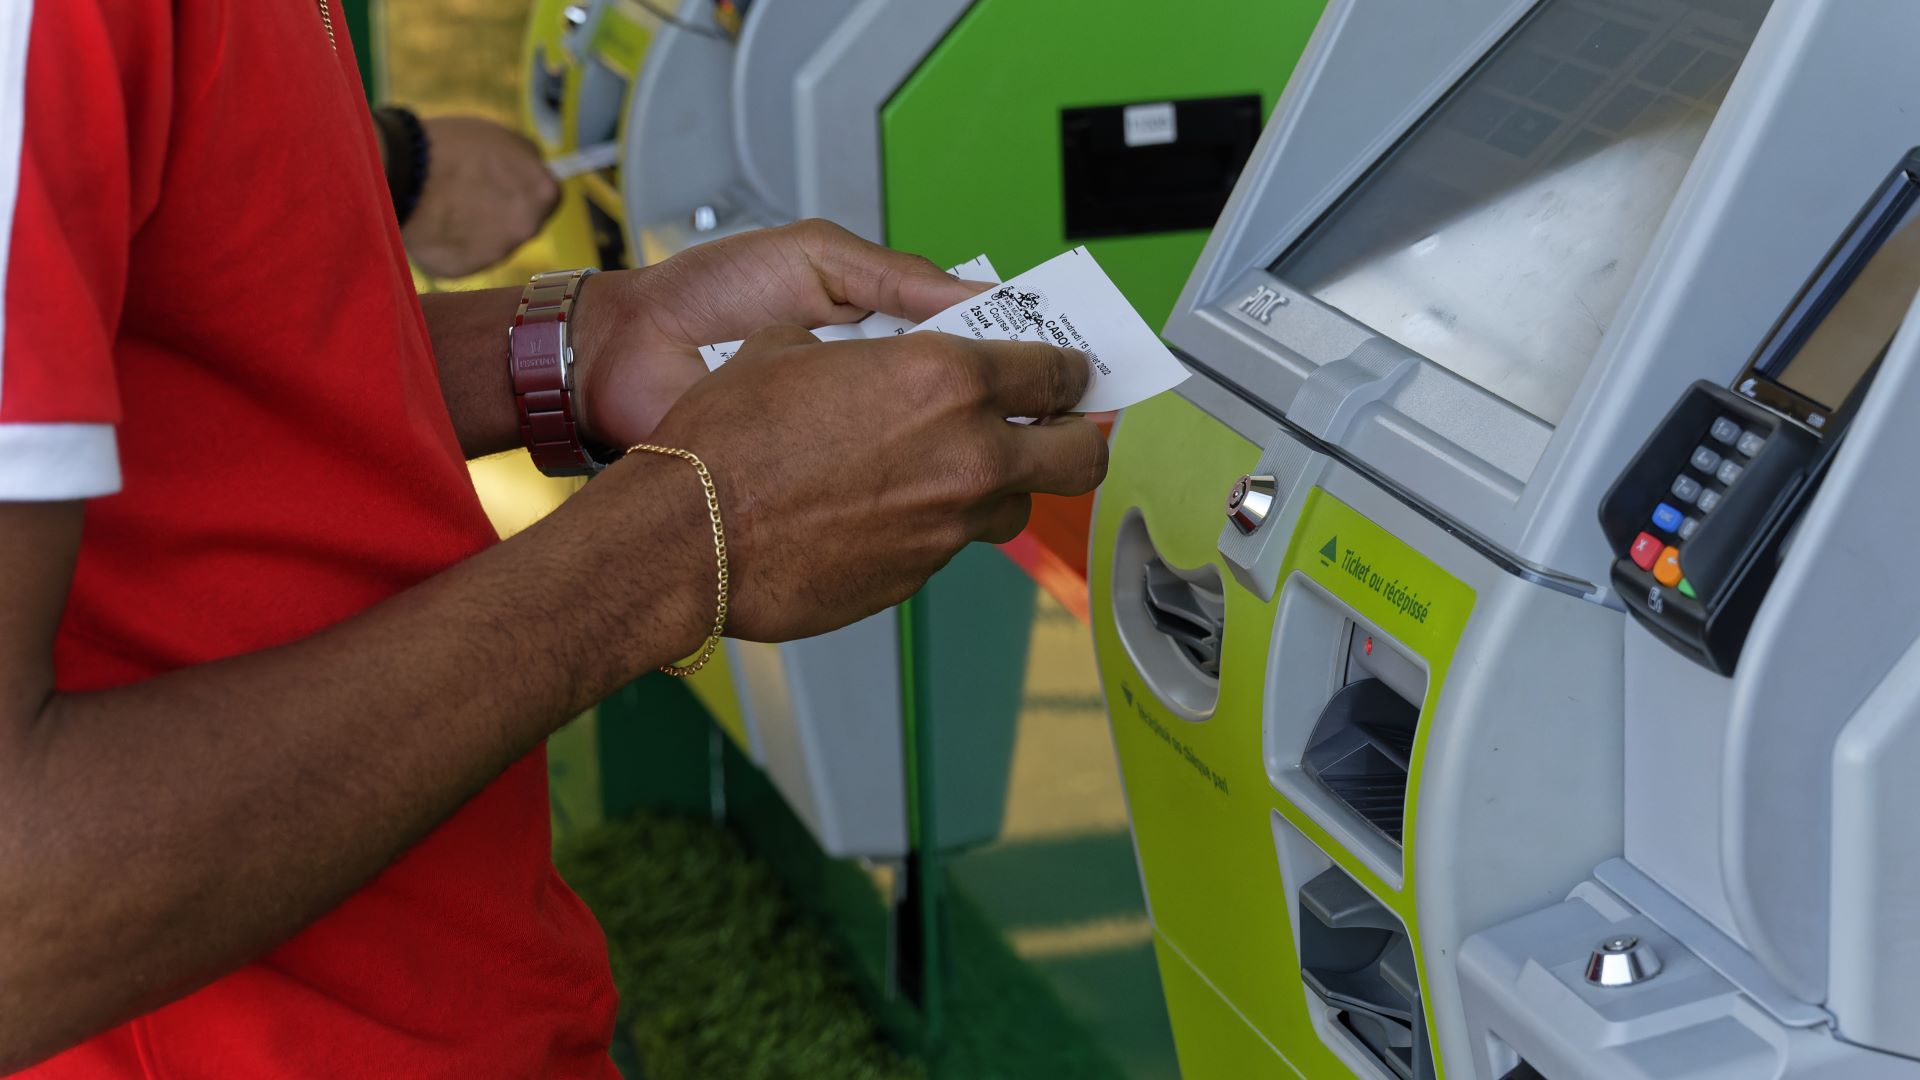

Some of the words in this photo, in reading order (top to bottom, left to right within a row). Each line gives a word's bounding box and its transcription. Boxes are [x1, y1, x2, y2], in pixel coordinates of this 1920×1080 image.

[960, 311, 975, 327] Unité
[970, 305, 993, 329] 2sur4
[989, 307, 1010, 331] Course
[996, 301, 1022, 331] HIPPODROME
[1002, 295, 1014, 308] PARI
[1010, 306, 1028, 327] MUTUEL
[1059, 313, 1082, 341] Vendredi
[1079, 341, 1089, 350] 15
[1097, 362, 1111, 376] 2022
[520, 356, 556, 368] FESTINA
[1341, 548, 1371, 584] Ticket
[1368, 573, 1384, 593] ou
[1382, 579, 1431, 624] récépissé
